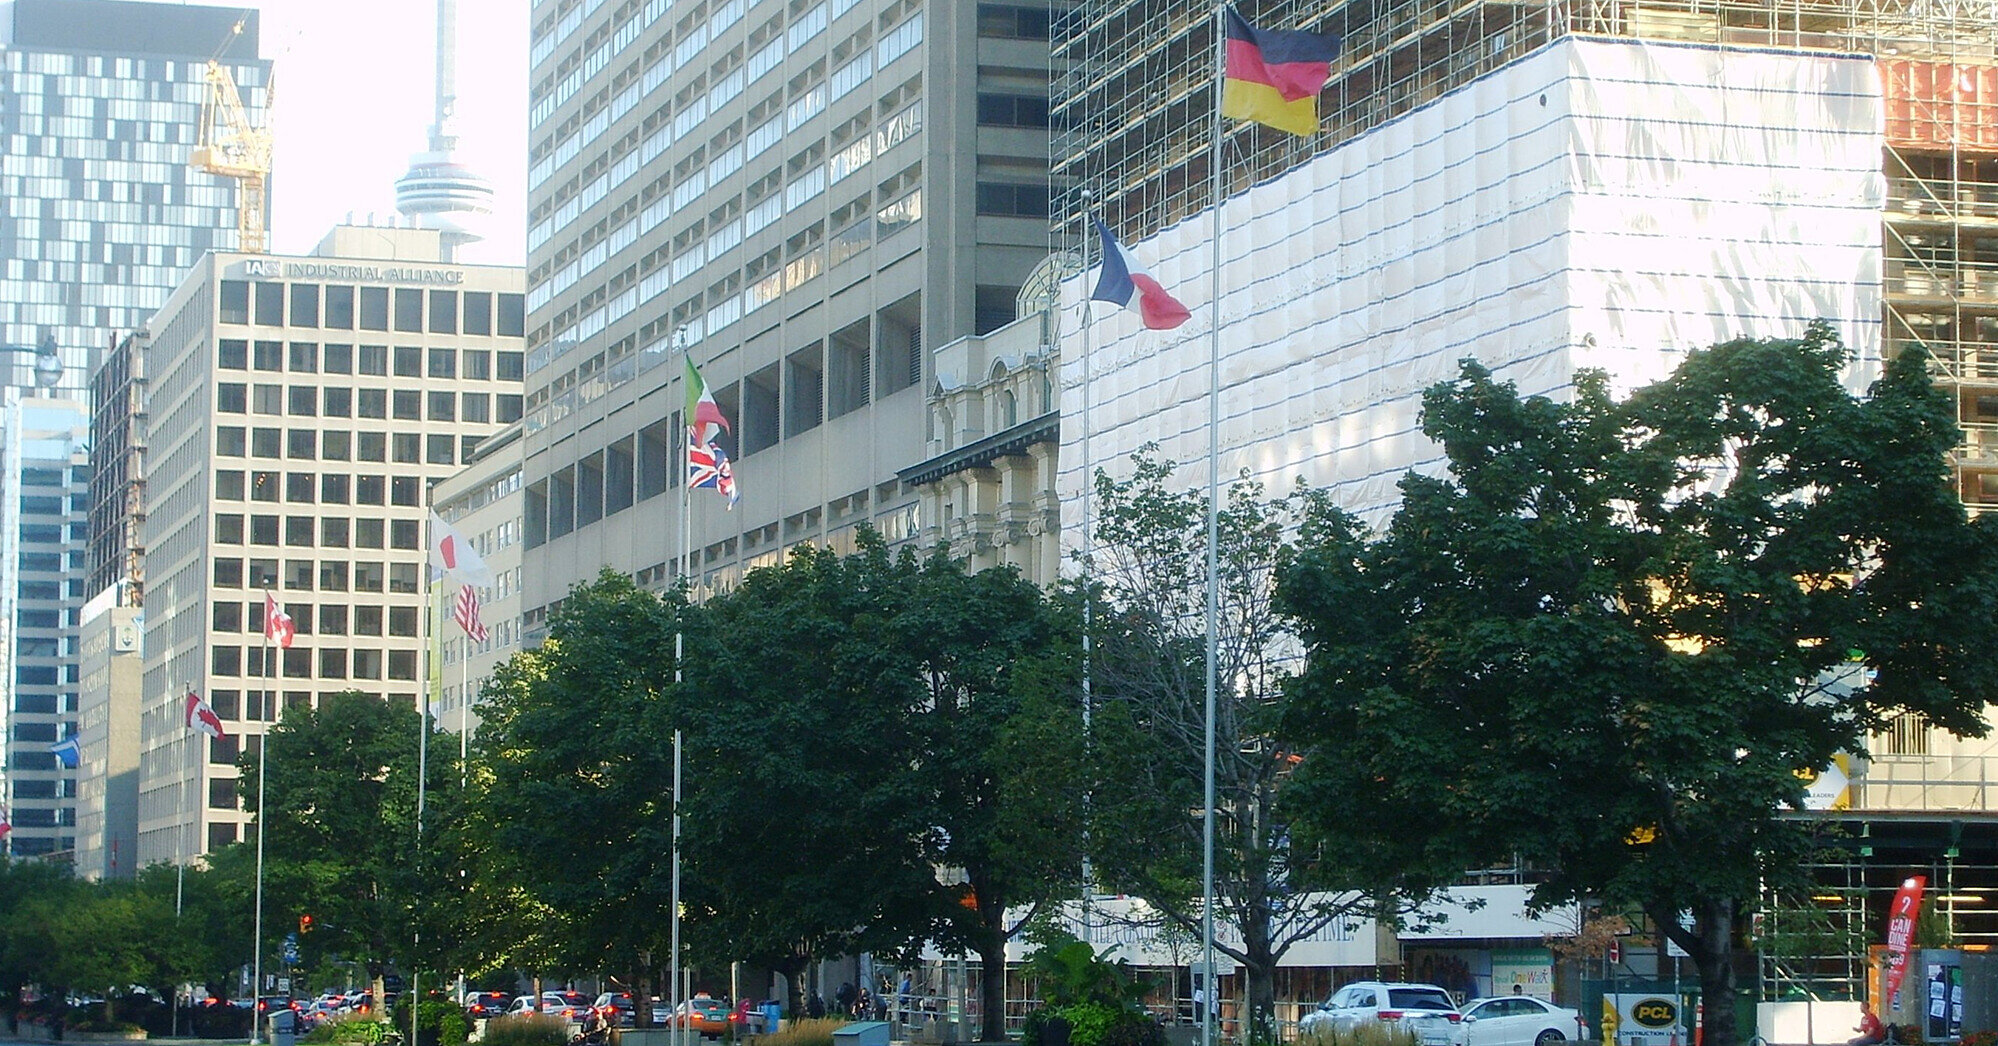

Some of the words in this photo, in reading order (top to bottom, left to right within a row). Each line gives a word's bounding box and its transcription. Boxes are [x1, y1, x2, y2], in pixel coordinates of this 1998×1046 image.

[288, 262, 383, 281] INDUSTRIAL
[390, 267, 464, 284] ALLIANCE
[1890, 917, 1912, 934] CAN
[1888, 931, 1909, 947] DINE
[1638, 1005, 1672, 1019] PCL
